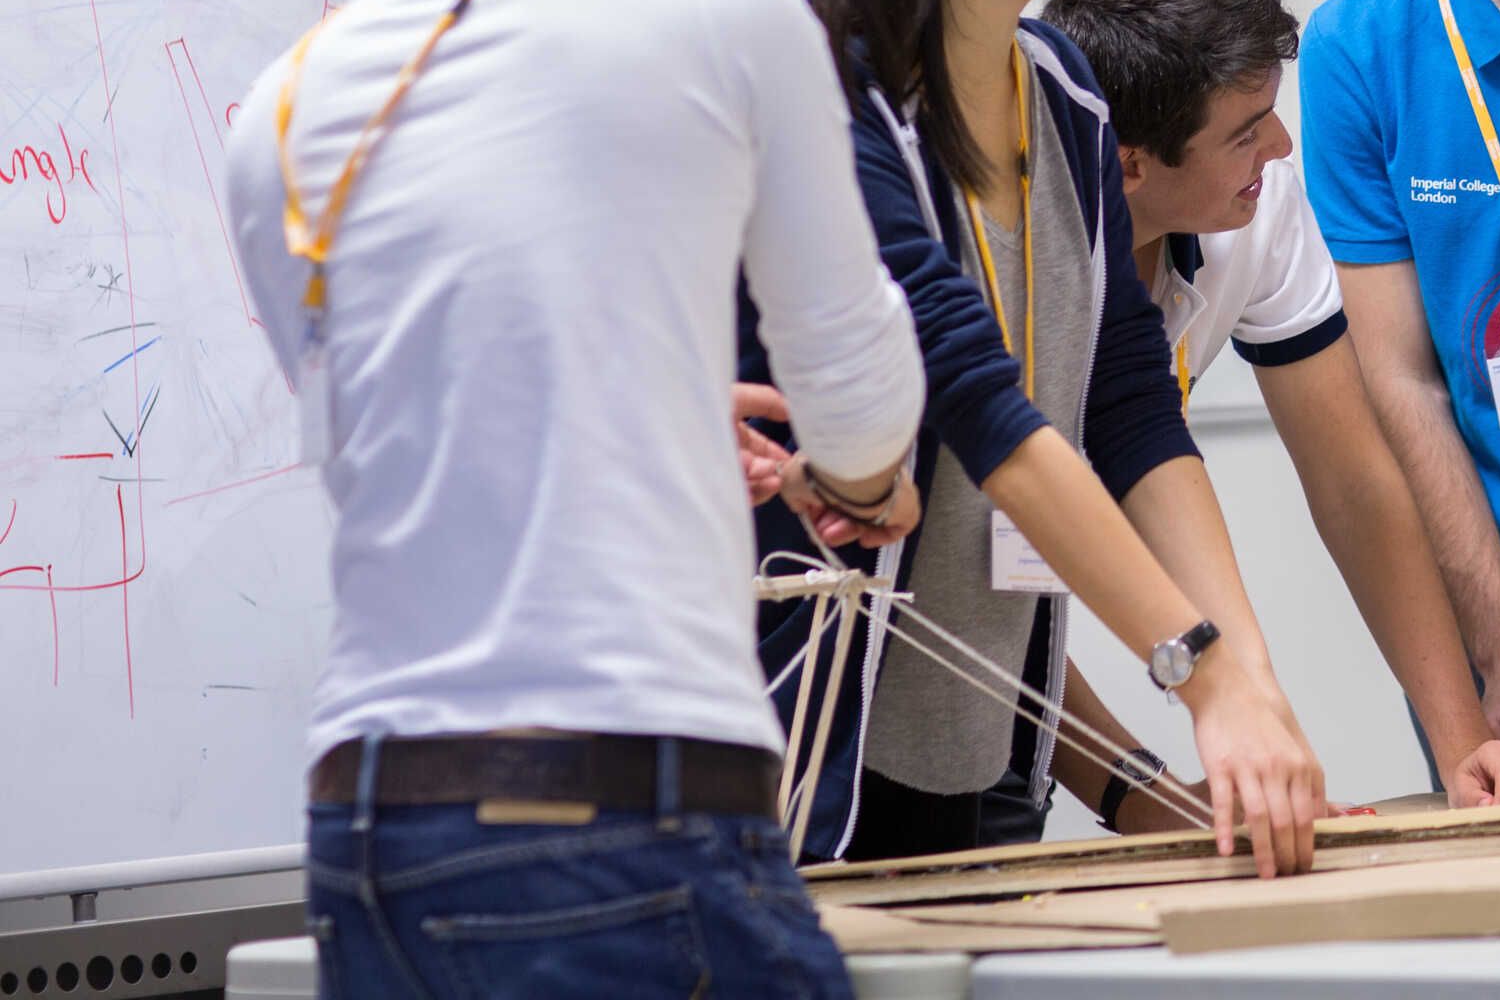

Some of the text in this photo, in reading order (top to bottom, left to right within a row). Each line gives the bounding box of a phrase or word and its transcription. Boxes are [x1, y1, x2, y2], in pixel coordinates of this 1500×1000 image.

[1410, 176, 1500, 196] Imperial College
[1411, 189, 1457, 204] London
